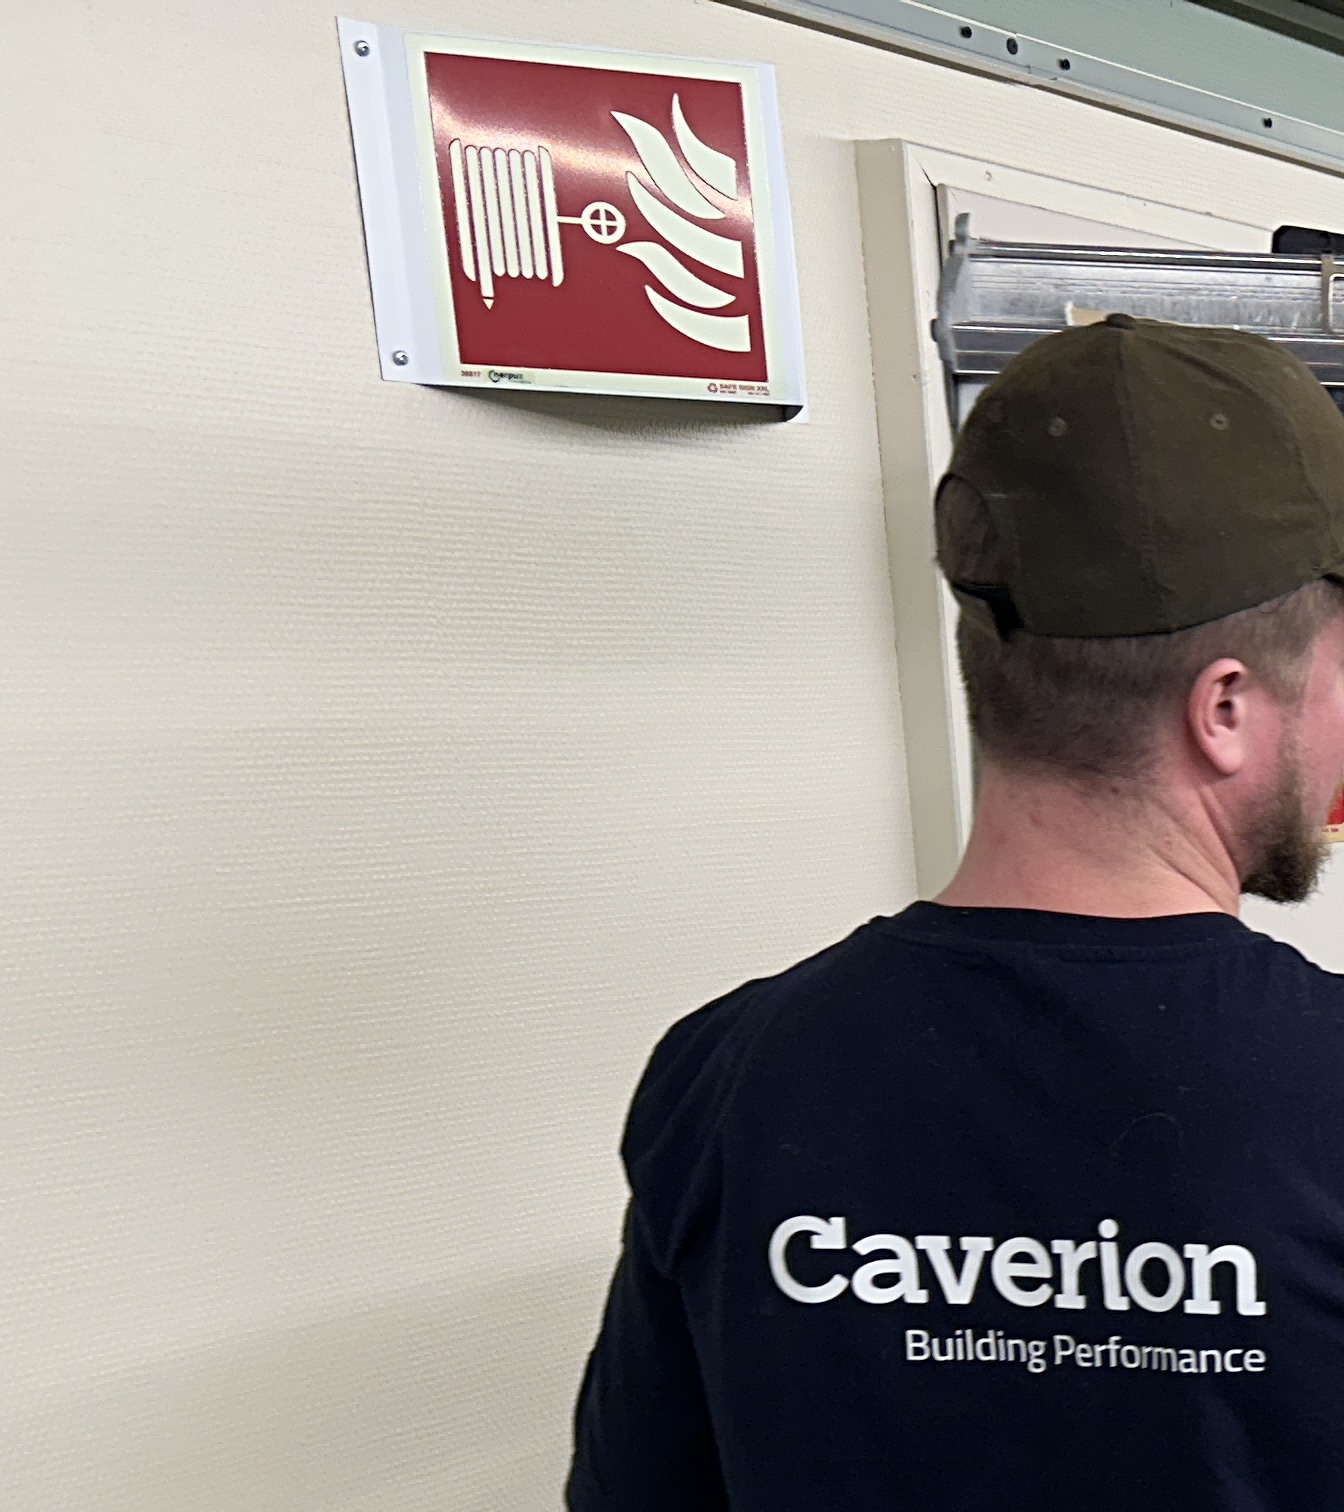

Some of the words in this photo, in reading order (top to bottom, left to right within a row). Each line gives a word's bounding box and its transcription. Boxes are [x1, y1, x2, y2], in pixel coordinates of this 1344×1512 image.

[768, 1215, 1267, 1316] Caverion
[905, 1328, 1047, 1373] Building
[1053, 1334, 1267, 1374] Performance
